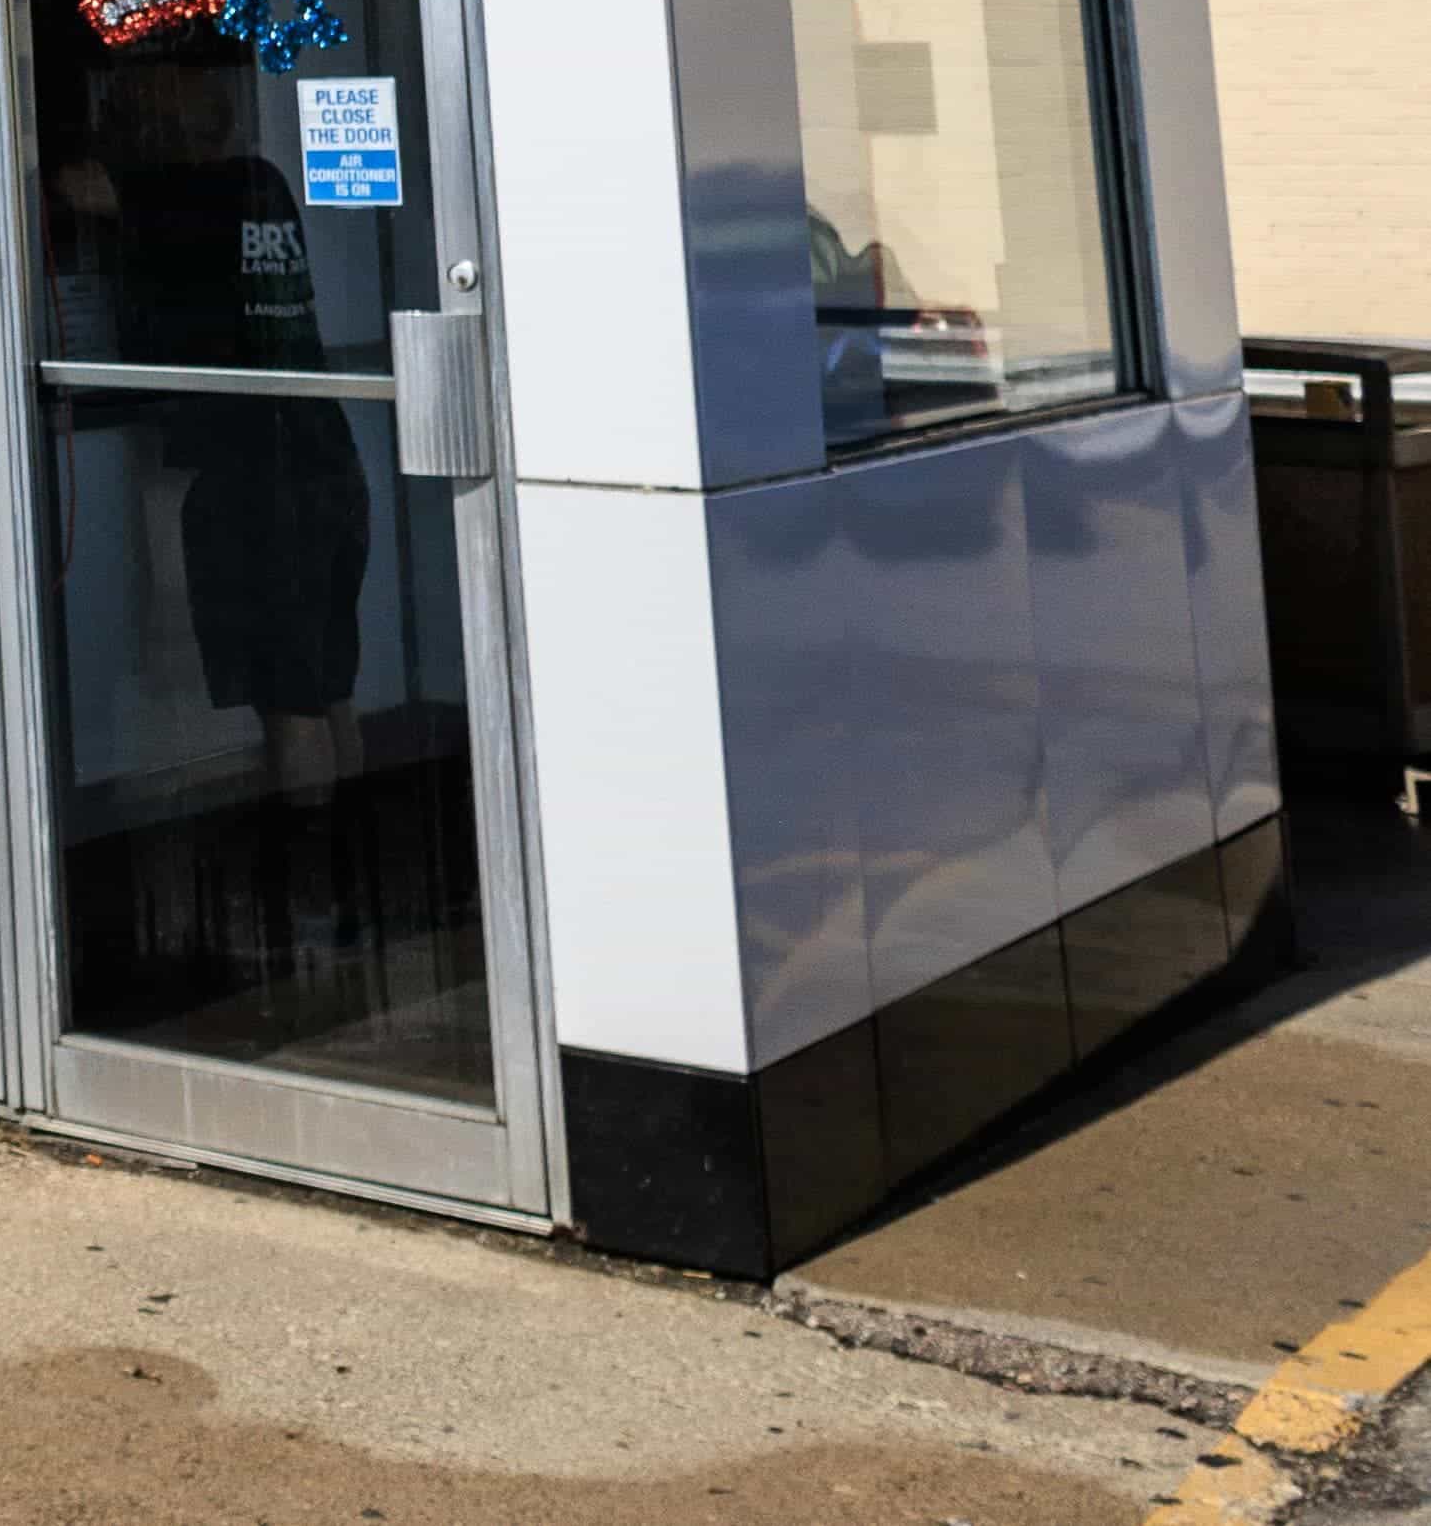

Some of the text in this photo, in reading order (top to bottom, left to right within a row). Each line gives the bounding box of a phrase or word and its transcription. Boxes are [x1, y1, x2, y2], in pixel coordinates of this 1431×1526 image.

[315, 89, 380, 106] PLEASE
[321, 108, 376, 125] CLOSE
[308, 128, 392, 144] THE DOOR
[339, 154, 363, 168] AIR
[309, 168, 395, 183] CONDITIONER
[335, 183, 371, 197] IS ON
